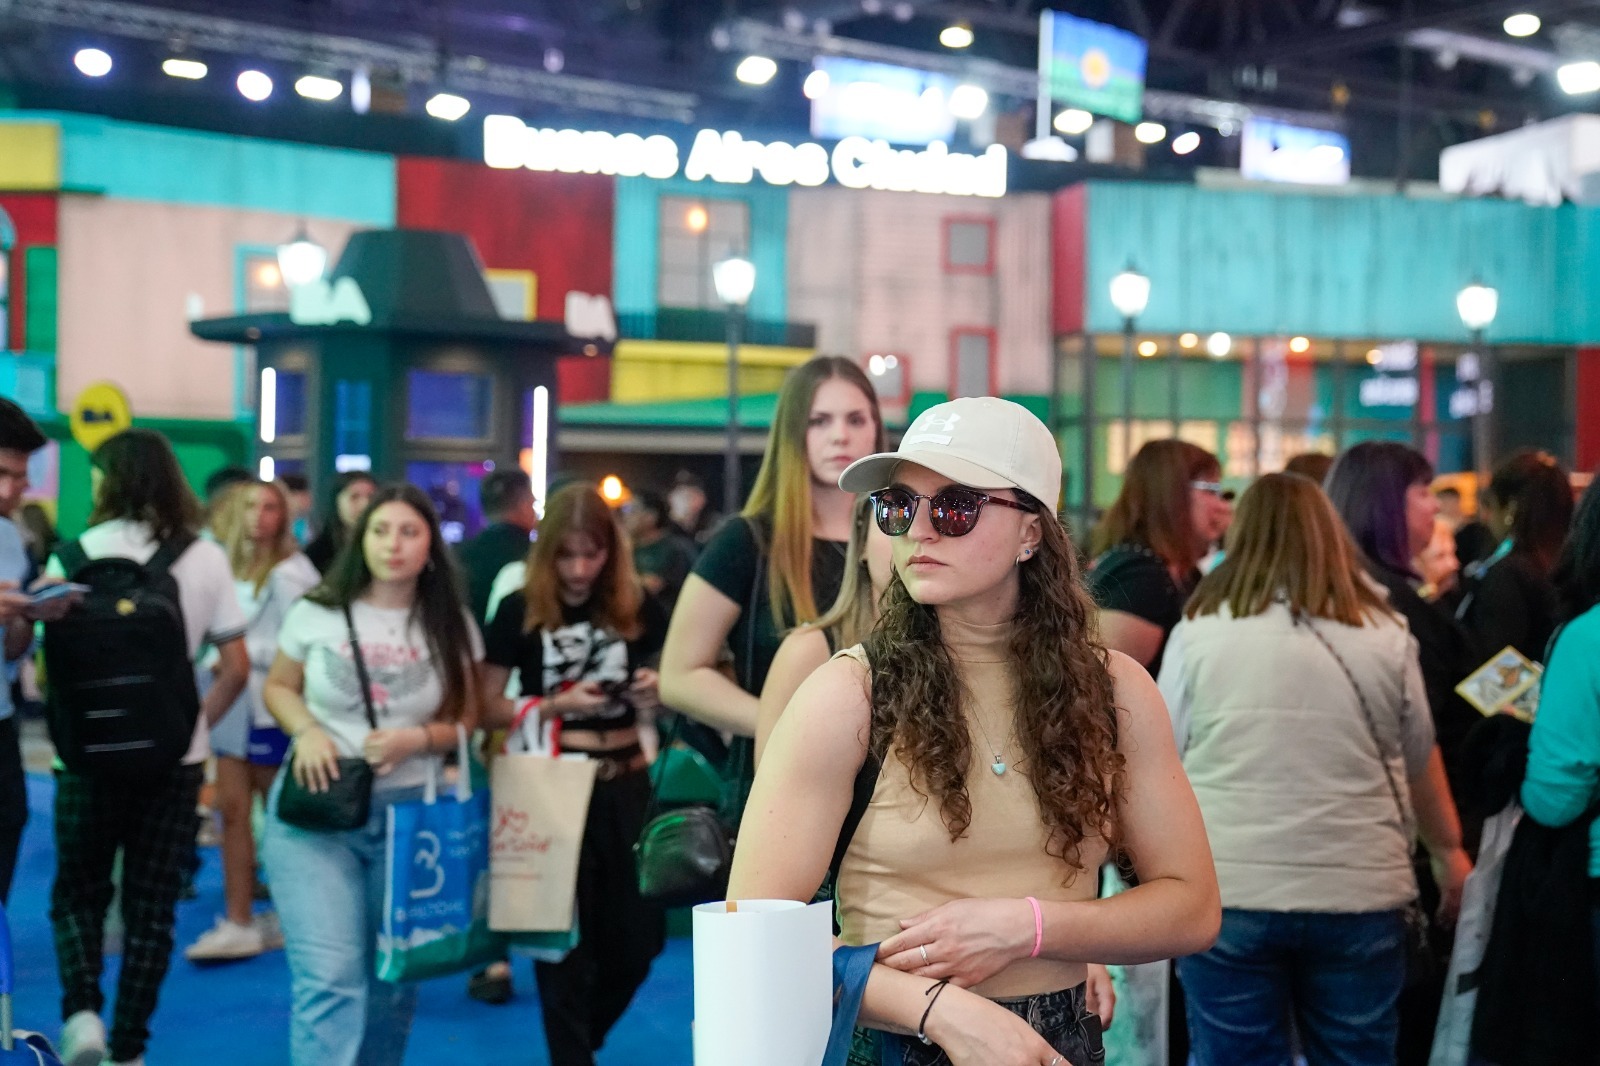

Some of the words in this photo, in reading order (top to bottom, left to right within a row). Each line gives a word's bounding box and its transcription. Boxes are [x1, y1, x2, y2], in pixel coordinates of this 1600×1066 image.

[484, 114, 678, 179] Buenos
[686, 128, 828, 186] Aires
[832, 136, 1007, 197] Ciudad
